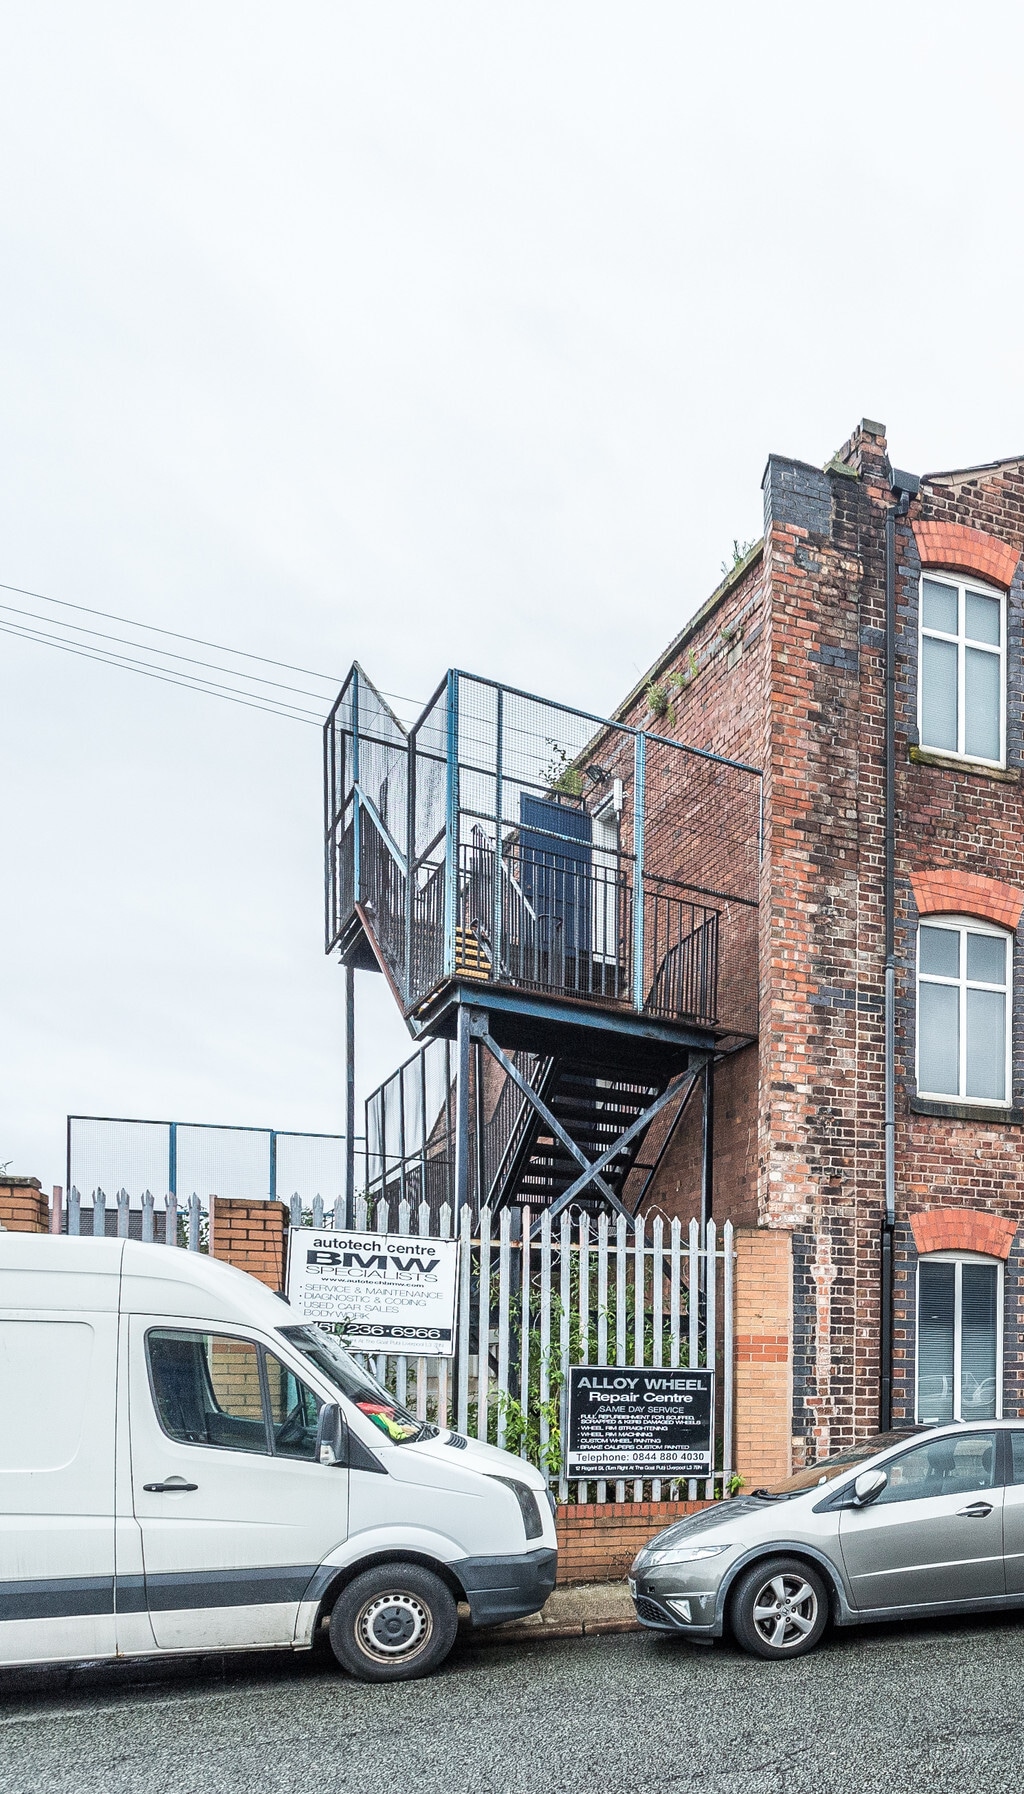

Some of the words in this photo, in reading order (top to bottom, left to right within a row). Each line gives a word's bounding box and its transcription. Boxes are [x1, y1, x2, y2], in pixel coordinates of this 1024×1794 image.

[313, 1238, 381, 1252] autotech
[387, 1244, 436, 1256] centre
[306, 1250, 440, 1273] BMW
[305, 1265, 438, 1283] SPECIALISTS
[321, 1277, 425, 1288] www.autotechbmw.com
[305, 1283, 351, 1294] SERVICE
[366, 1287, 443, 1300] MAINTENANCE
[304, 1292, 370, 1304] DIAGNOSTIC
[385, 1297, 426, 1306] CODING
[303, 1301, 334, 1309] USED
[338, 1303, 361, 1311] CAR
[365, 1305, 399, 1313] SALES
[577, 1377, 640, 1390] ALLOY
[644, 1378, 707, 1391] WHEEL
[589, 1391, 640, 1403] Repair
[643, 1392, 693, 1403] Centre
[600, 1405, 626, 1413] SAME
[648, 1406, 684, 1414] SERVICE
[576, 1454, 629, 1462] Telephone:
[632, 1453, 656, 1461] 0844
